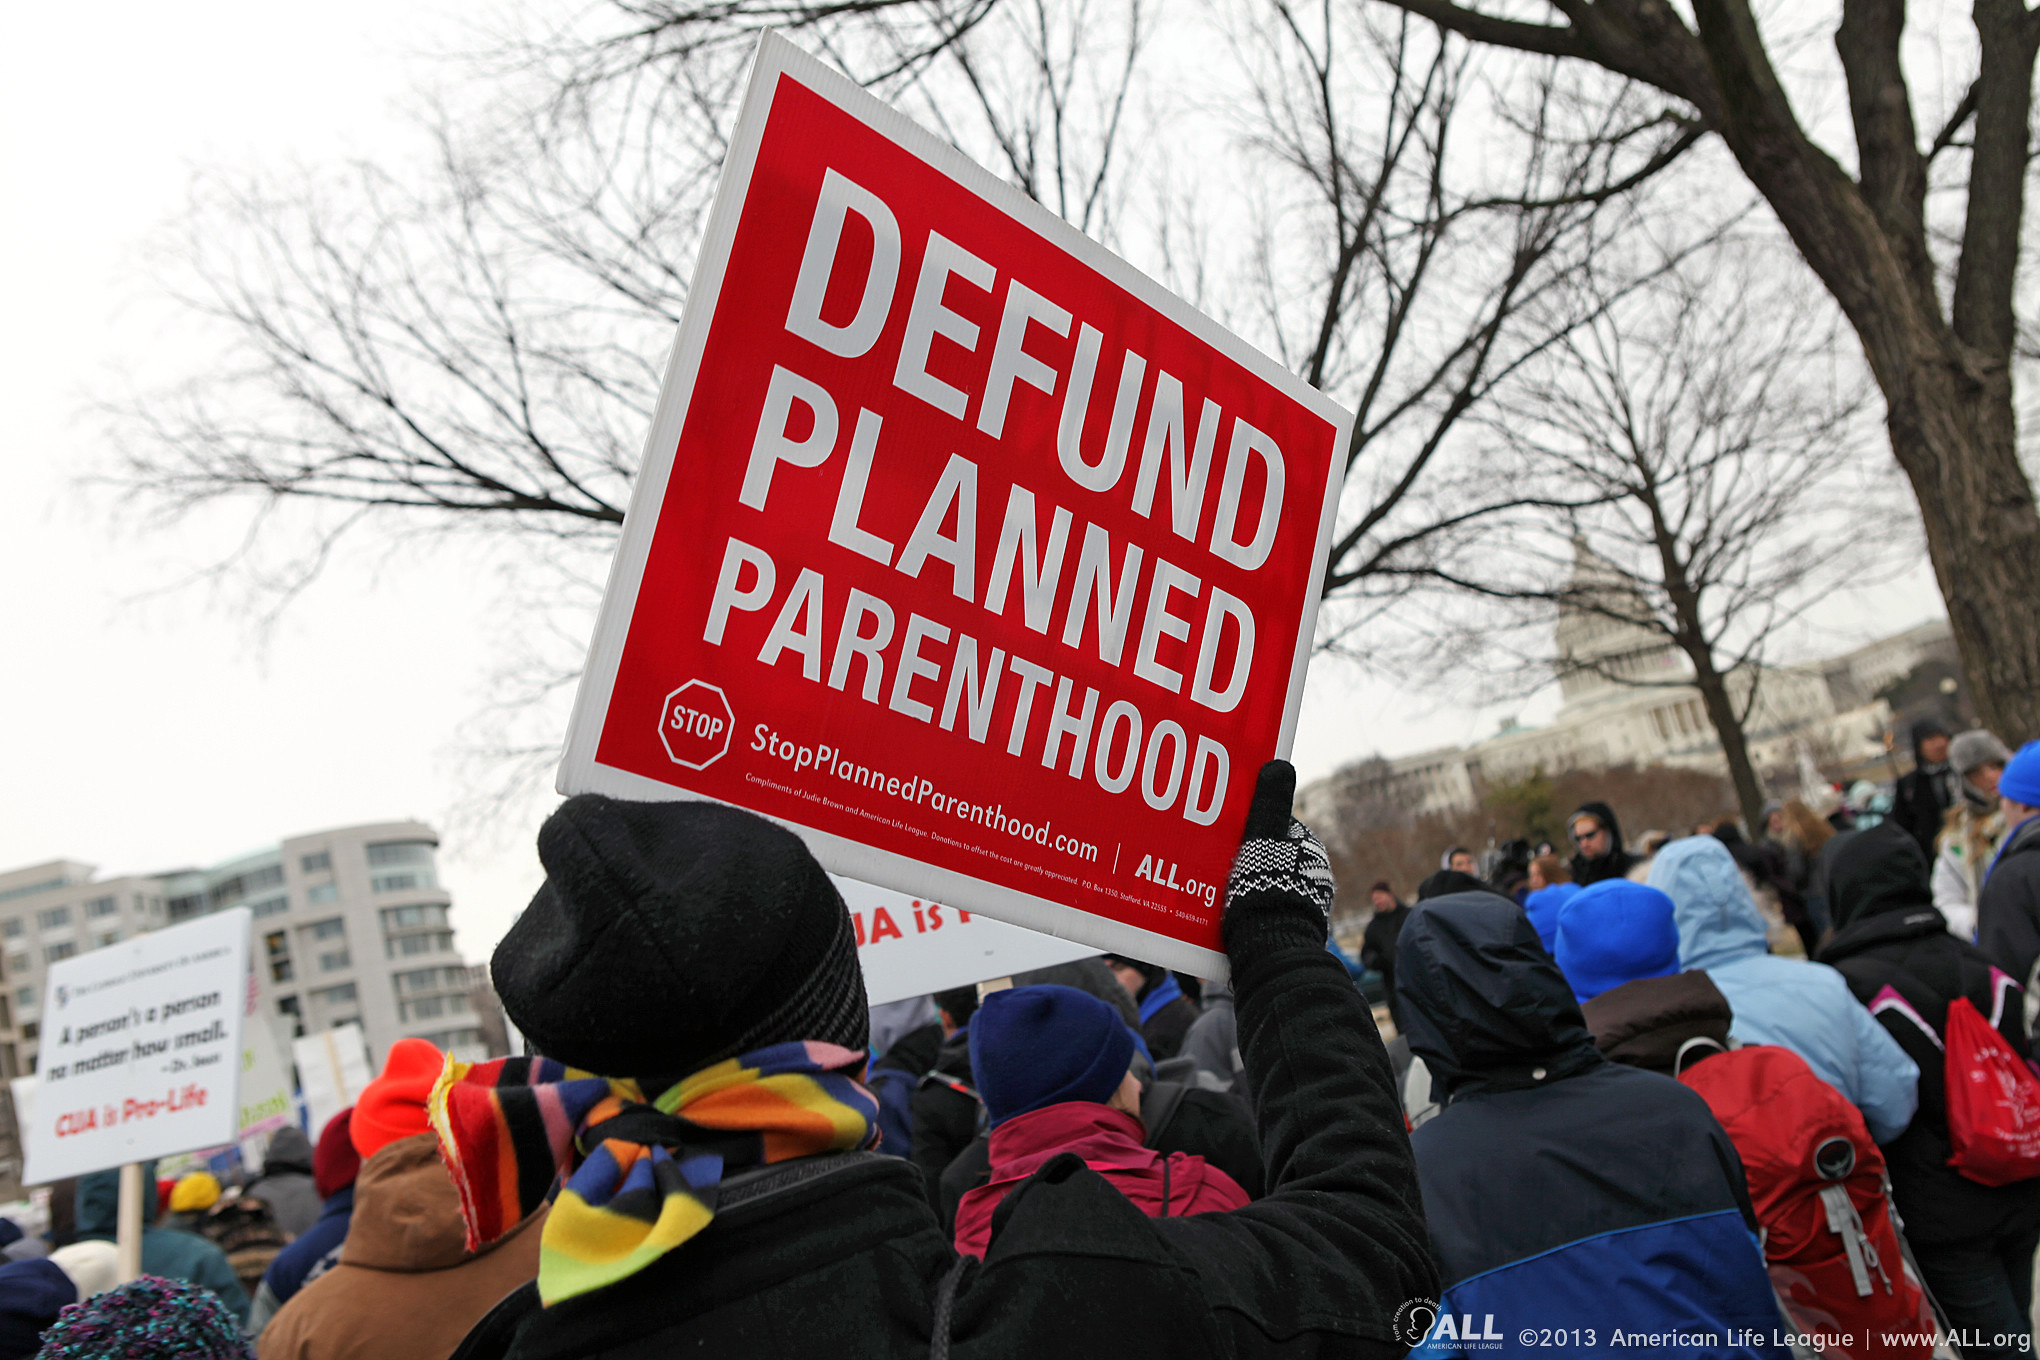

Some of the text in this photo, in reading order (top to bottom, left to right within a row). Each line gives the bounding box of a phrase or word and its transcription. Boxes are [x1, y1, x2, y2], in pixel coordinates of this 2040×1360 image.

[784, 166, 1286, 571] DEFUND
[739, 363, 1256, 713] PLANNED
[670, 705, 724, 740] STOP
[703, 536, 1231, 827] PARENTHOOD
[745, 772, 793, 795] Compliments
[793, 789, 802, 797] of
[802, 791, 821, 804] Judie
[822, 797, 844, 811] Brown
[845, 805, 859, 815] and
[859, 808, 891, 826] American
[891, 818, 904, 829] Life
[904, 823, 929, 838] League.
[931, 831, 962, 849] Donations
[963, 842, 970, 851] to
[971, 845, 989, 857] offset
[989, 851, 999, 860] the
[1000, 855, 1013, 865] cost
[1013, 859, 1024, 868] are
[1024, 862, 1044, 876] greatly
[1044, 869, 1079, 886] appreciated.
[1143, 898, 1151, 908] VA
[1150, 901, 1168, 914] 22555
[750, 723, 1217, 908] StopPlannedParenthood.com ALL.org
[911, 900, 944, 934] is
[160, 991, 221, 1024] person
[72, 1048, 130, 1076] matter
[132, 1038, 169, 1062] how
[55, 1108, 97, 1138] CUA
[103, 1104, 118, 1128] is
[122, 1083, 208, 1123] Pro-Life
